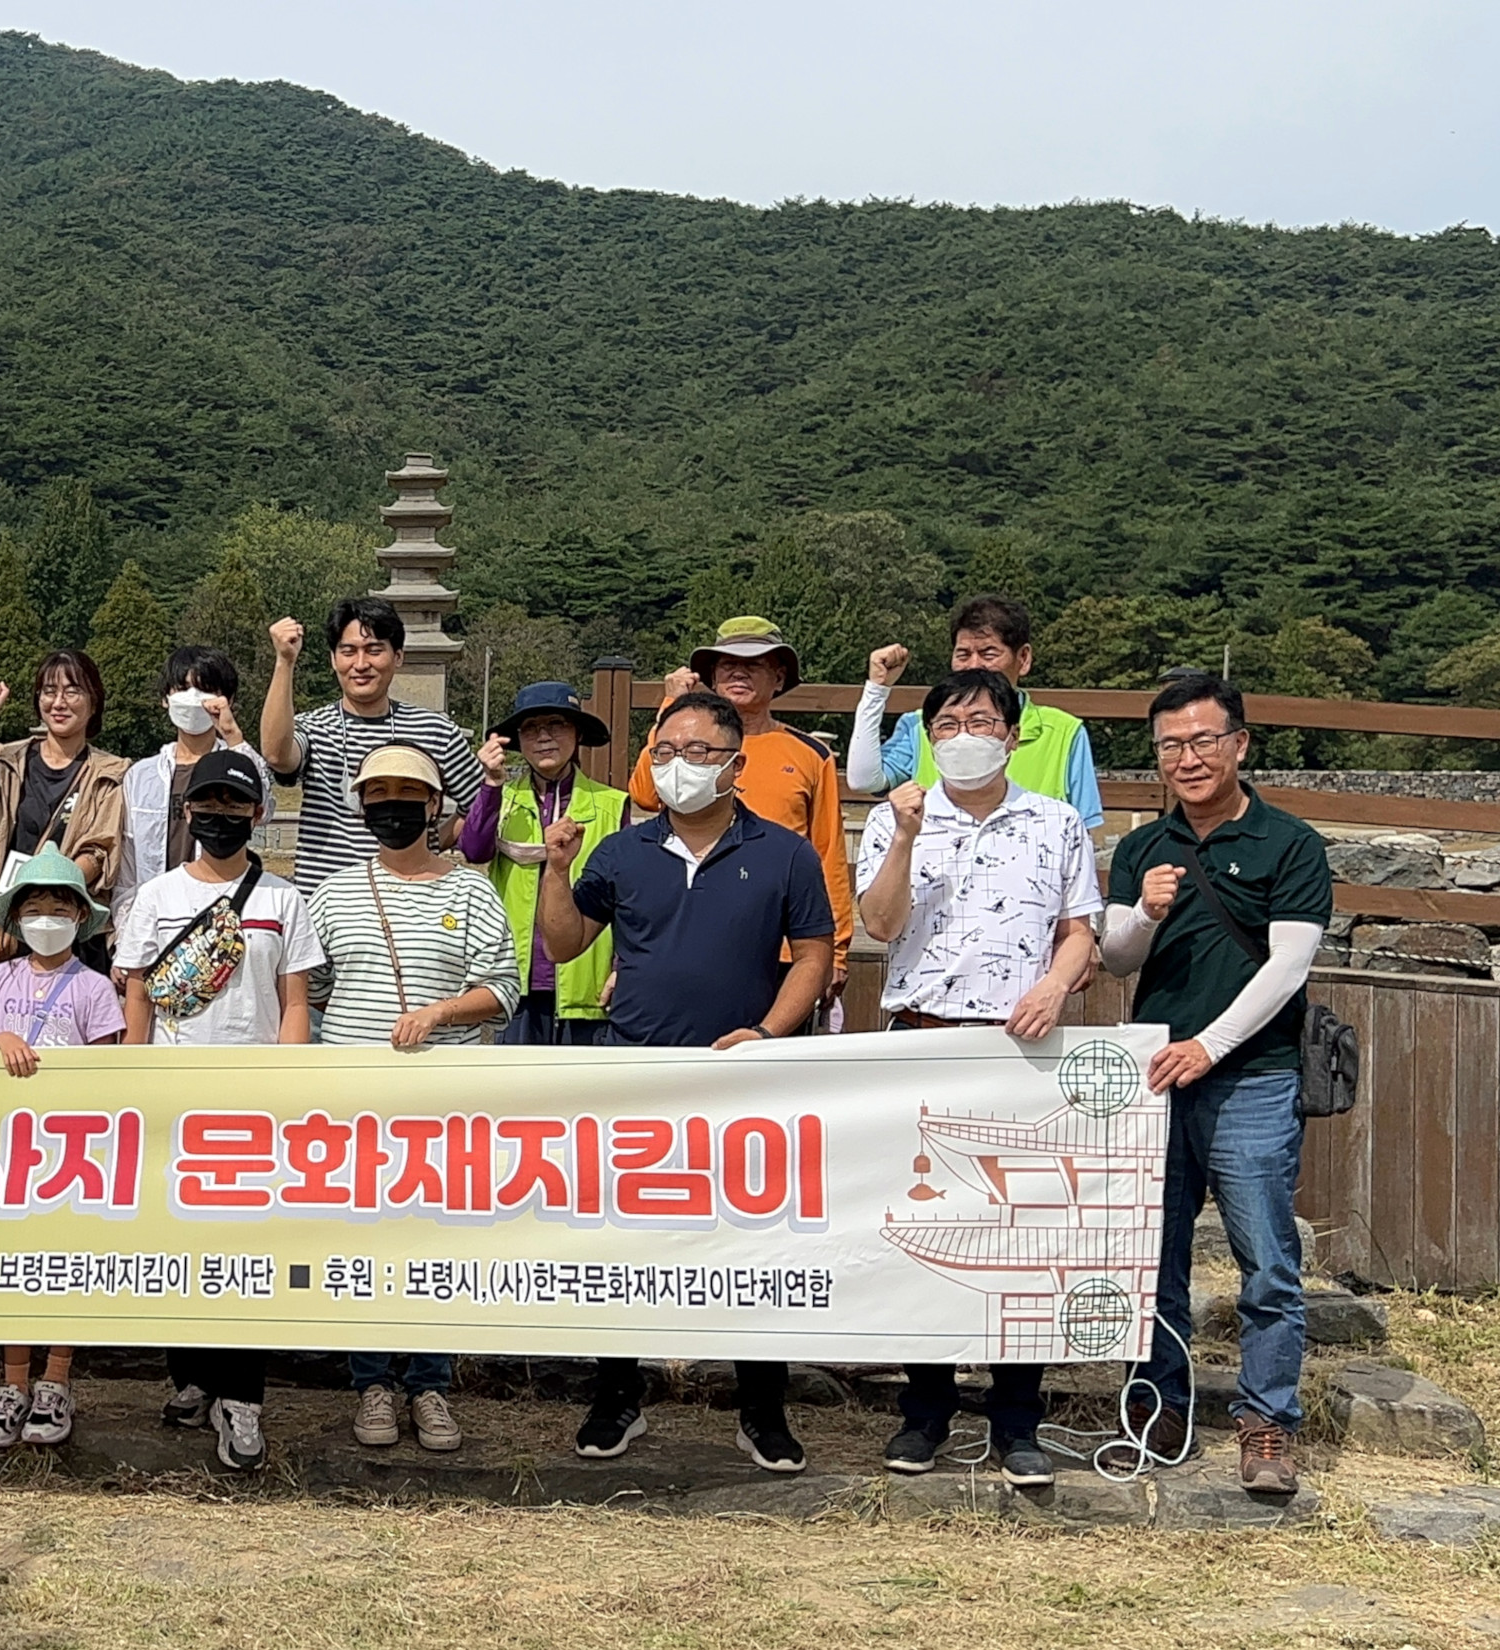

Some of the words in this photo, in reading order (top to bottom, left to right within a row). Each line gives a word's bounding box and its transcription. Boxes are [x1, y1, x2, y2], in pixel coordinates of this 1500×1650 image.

[174, 1112, 825, 1219] 문화재지킴이
[200, 1255, 274, 1295] 봉사단
[324, 1257, 374, 1298] 후원
[405, 1259, 833, 1308] 보령시,(사)한국문화재지킴이단체연합
